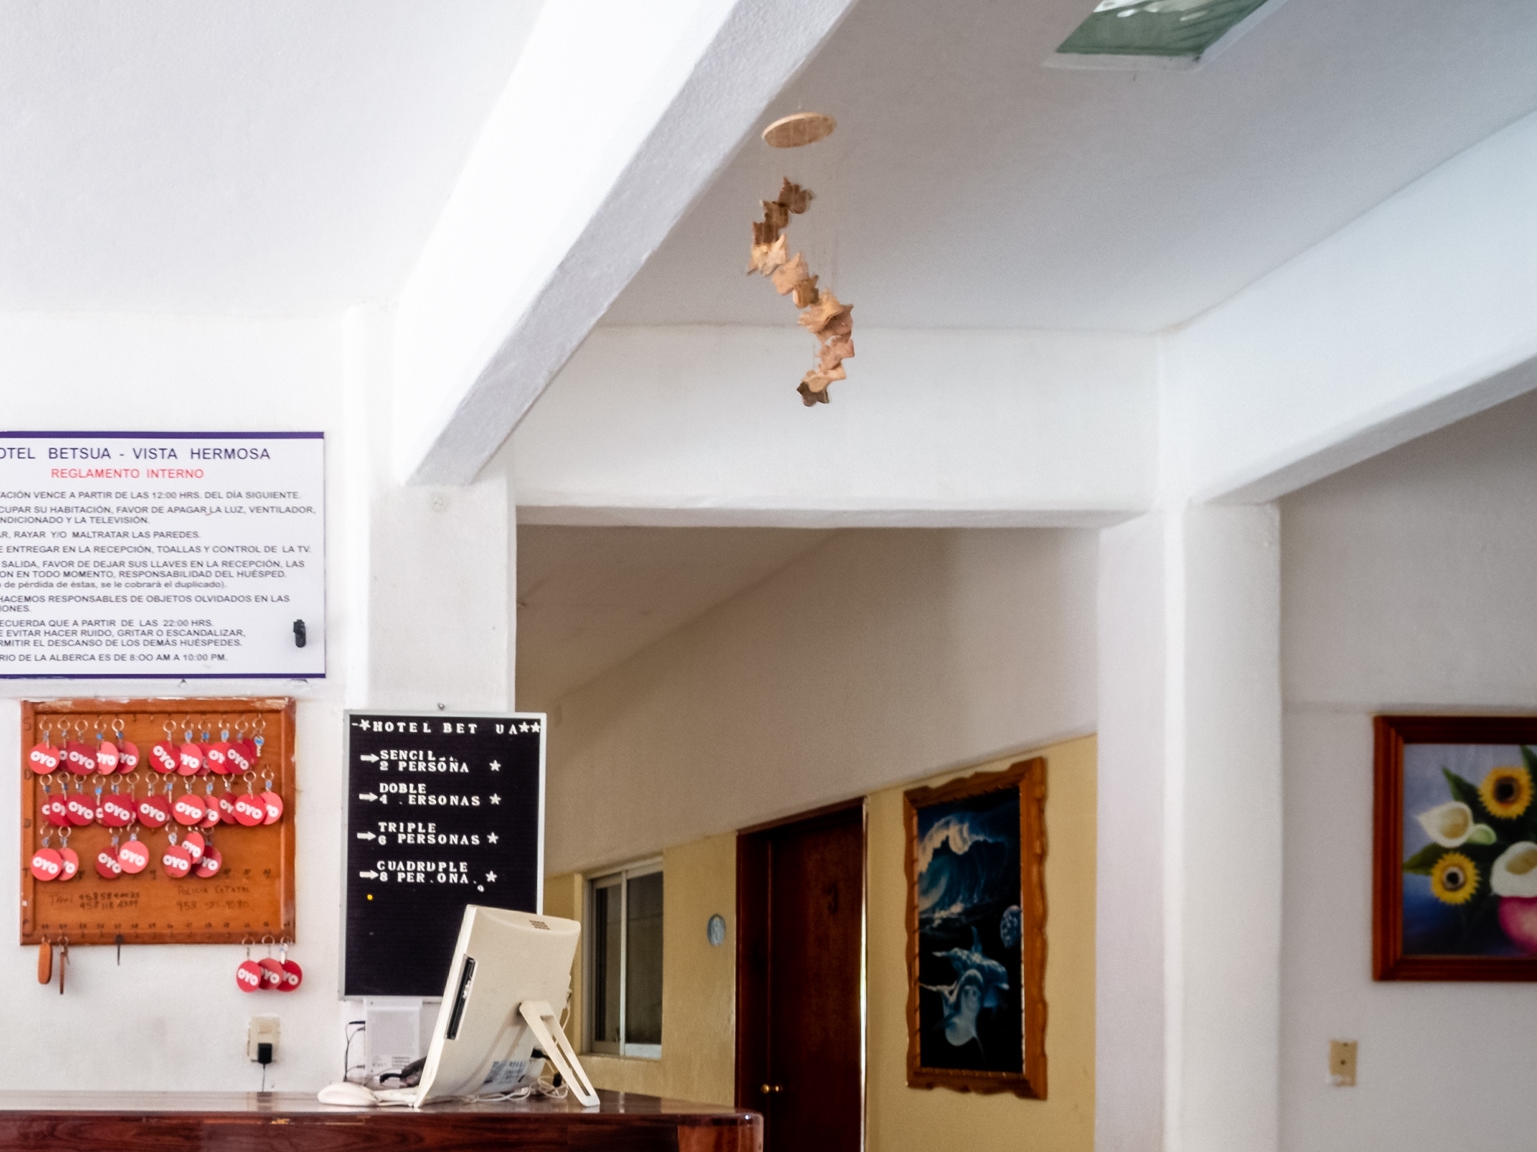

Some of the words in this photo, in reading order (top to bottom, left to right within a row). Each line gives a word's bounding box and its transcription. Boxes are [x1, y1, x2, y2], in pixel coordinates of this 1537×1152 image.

[48, 448, 112, 460] BETSUA
[132, 448, 178, 460] VISTA
[190, 448, 271, 460] HERMOSA
[51, 468, 140, 479] REGLAMENTO
[146, 468, 205, 479] INTERNO
[33, 491, 67, 499] VENCE
[77, 491, 113, 499] PARTIR
[114, 491, 128, 499] DE
[130, 491, 150, 499] LAS
[152, 491, 178, 499] 12:00
[178, 491, 203, 499] HRS.
[204, 491, 224, 499] DEL
[225, 490, 243, 499] DÍA
[245, 491, 301, 499] SIGUIENTE.
[33, 505, 48, 514] SU
[49, 504, 114, 515] HABITACIÓN,
[115, 505, 149, 514] FAVOR
[150, 505, 165, 514] DE
[166, 505, 208, 514] APAGAR
[208, 505, 223, 514] LA
[224, 505, 246, 515] LUZ,
[248, 505, 316, 515] VENTILADOR,
[74, 516, 87, 524] LA
[89, 515, 151, 524] TELEVISIÓN.
[13, 530, 46, 539] RAYAR
[50, 530, 68, 539] Y/O
[71, 530, 130, 539] MALTRATAR
[131, 530, 151, 539] LAS
[152, 530, 202, 539] PAREDES.
[5, 545, 61, 554] ENTREGAR
[62, 545, 77, 554] EN
[78, 545, 92, 554] LA
[93, 544, 154, 555] RECEPCIÓN,
[156, 545, 202, 554] TOALLAS
[211, 545, 261, 554] CONTROL
[263, 545, 278, 554] DE
[281, 545, 296, 554] LA
[297, 545, 313, 554] TV.
[1, 560, 40, 569] SALIDA,
[42, 560, 75, 568] FAVOR
[77, 560, 91, 568] DE
[92, 560, 126, 568] DEJAR
[127, 560, 149, 568] SUS
[150, 560, 188, 568] LLAVES
[189, 560, 204, 568] EN
[205, 560, 220, 568] LA
[221, 559, 283, 569] RECEPCIÓN,
[285, 560, 305, 568] LAS
[16, 570, 30, 578] EN
[32, 570, 61, 578] TODO
[62, 570, 116, 579] MOMENTO,
[118, 570, 213, 578] RESPONSABILIDAD
[214, 570, 234, 578] DEL
[236, 569, 288, 578] HUÉSPED.
[47, 594, 128, 603] RESPONSABLES
[129, 594, 144, 603] DE
[145, 594, 193, 603] OBJETOS
[194, 594, 252, 603] OLVIDADOS
[254, 594, 269, 603] EN
[270, 594, 291, 603] LAS
[48, 619, 70, 628] QUE
[81, 619, 117, 627] PARTIR
[120, 619, 134, 627] DE
[138, 619, 159, 627] LAS
[162, 619, 190, 627] 22:00
[190, 619, 215, 627] HRS.
[5, 629, 42, 638] EVITAR
[43, 629, 78, 638] HACER
[80, 629, 115, 639] RUIDO,
[116, 629, 154, 638] GRITAR
[165, 629, 246, 639] ESCANDALIZAR,
[32, 639, 45, 647] EL
[47, 639, 103, 647] DESCANSO
[105, 639, 119, 647] DE
[120, 639, 141, 647] LOS
[142, 637, 178, 647] DEMÁS
[179, 637, 244, 647] HUÉSPEDES.
[18, 653, 32, 662] DE
[34, 653, 47, 662] LA
[49, 653, 96, 662] ALBERCA
[98, 653, 112, 662] ES
[113, 653, 127, 662] DE
[155, 653, 171, 662] AM
[183, 653, 209, 662] 10:00
[210, 653, 228, 662] PM.
[373, 722, 432, 734] HOTEL
[30, 750, 57, 768] OYO
[69, 751, 96, 770] OYO
[153, 745, 176, 769] OYO
[227, 748, 249, 770] OYO
[399, 762, 469, 773] PERSONA
[379, 784, 426, 794] DOBLE
[379, 794, 388, 804] 4
[399, 794, 481, 806] ERSONAS
[68, 801, 94, 820] OYO
[104, 802, 131, 819] OYO
[140, 804, 166, 822] OYO
[175, 802, 202, 819] OYO
[235, 801, 263, 819] OYO
[378, 822, 436, 833] TRIPLE
[378, 836, 387, 846] 6
[398, 834, 480, 846] PERSONAS
[98, 854, 121, 873] OYO
[119, 849, 145, 867] OYO
[163, 856, 188, 872] OYO
[33, 856, 59, 874] OYO
[379, 872, 388, 882] 8
[237, 968, 259, 986] OYO
